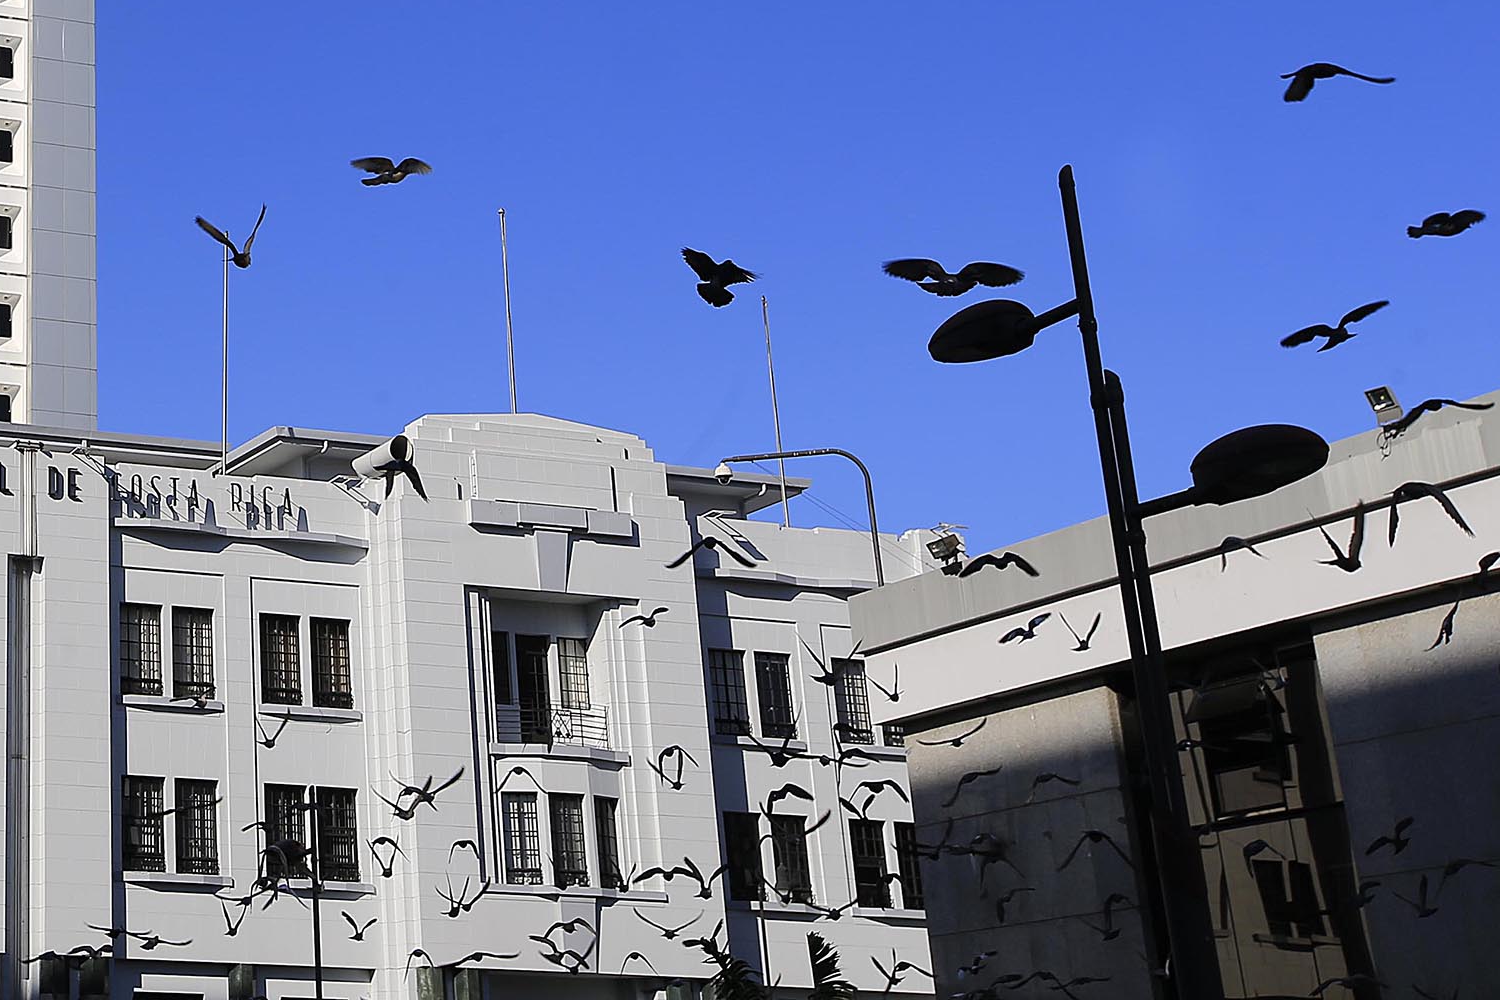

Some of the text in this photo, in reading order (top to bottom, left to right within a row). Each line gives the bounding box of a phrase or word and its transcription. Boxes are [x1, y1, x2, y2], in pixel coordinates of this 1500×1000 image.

[48, 464, 83, 502] DE
[114, 473, 199, 509] COSTA
[231, 483, 292, 516] RICA
